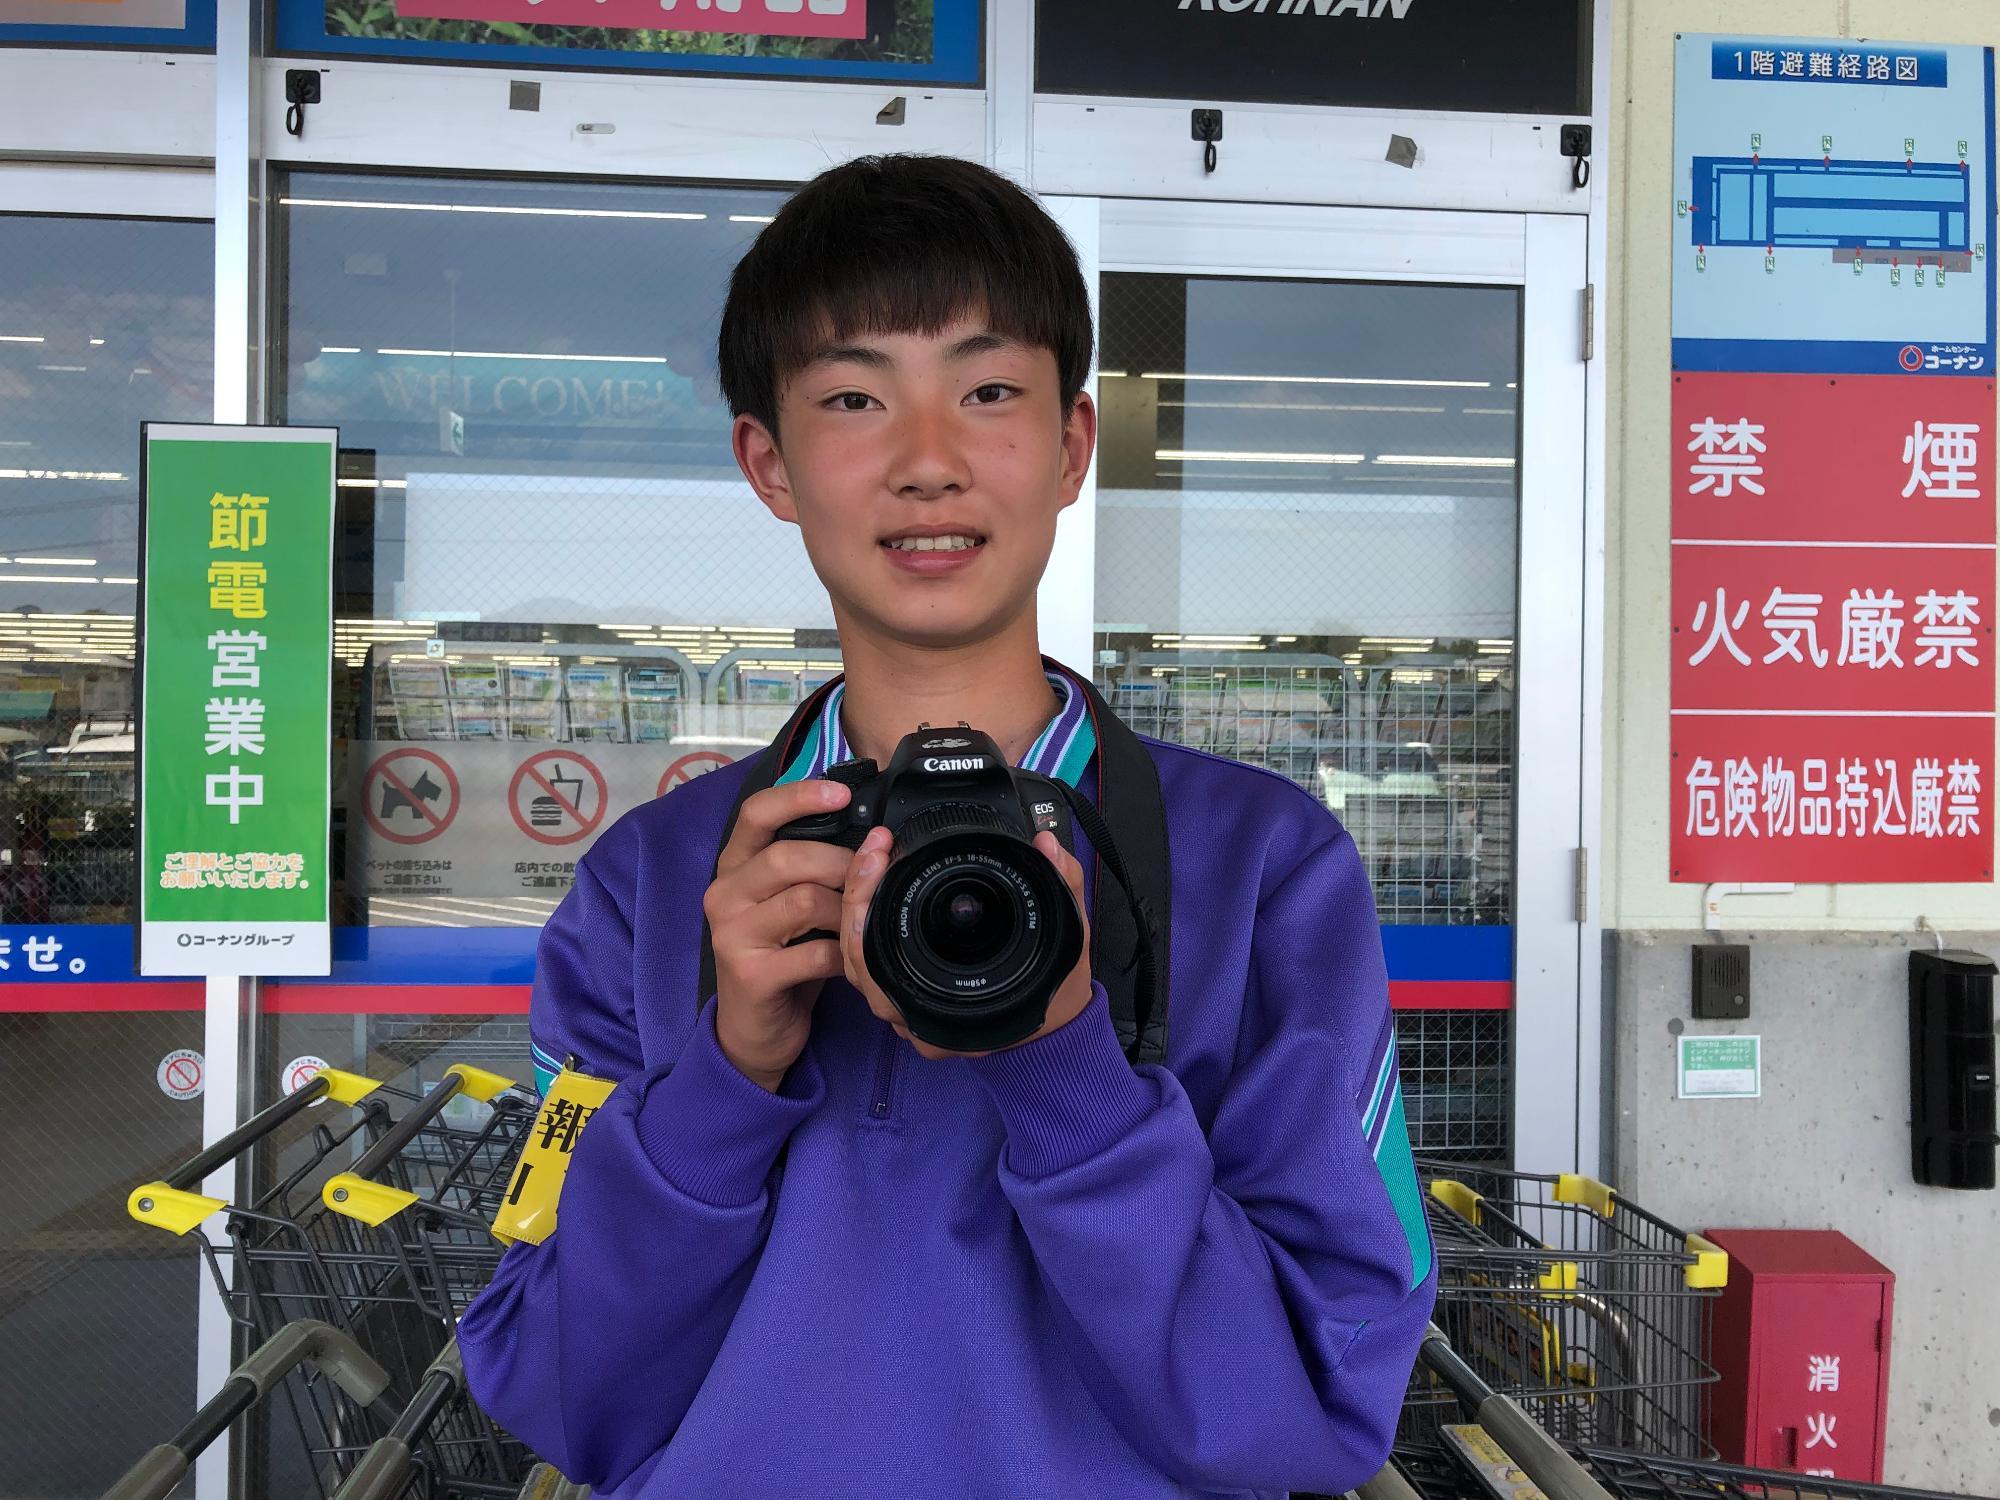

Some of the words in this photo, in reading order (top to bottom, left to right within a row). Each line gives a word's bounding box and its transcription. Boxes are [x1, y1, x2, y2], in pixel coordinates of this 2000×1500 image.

[1734, 51, 1918, 81] 1階避難経路図
[1925, 355, 1984, 370] コーナン
[374, 366, 666, 416] WELCOME!
[1687, 417, 1980, 498] 禁煙
[1689, 587, 1980, 668] 火気厳禁
[204, 492, 269, 824] 節電営業中
[924, 758, 984, 772] Canon
[1686, 756, 1981, 838] 危険物品持込厳禁
[1035, 803, 1054, 814] EOS
[165, 852, 304, 871] ご理解とご協力を
[944, 854, 962, 865] EF-S
[967, 854, 1002, 868] 18-55mm
[160, 870, 309, 889] お願いいたします。
[922, 862, 941, 878] LENS
[904, 878, 922, 903] ZOOM
[1006, 867, 1031, 897] 1:3.5-5.6
[1026, 899, 1034, 908] IS
[900, 906, 909, 938] CANON
[1028, 911, 1036, 929] STM
[193, 934, 295, 946] コーナングループ
[1805, 1354, 1841, 1479] 消火
